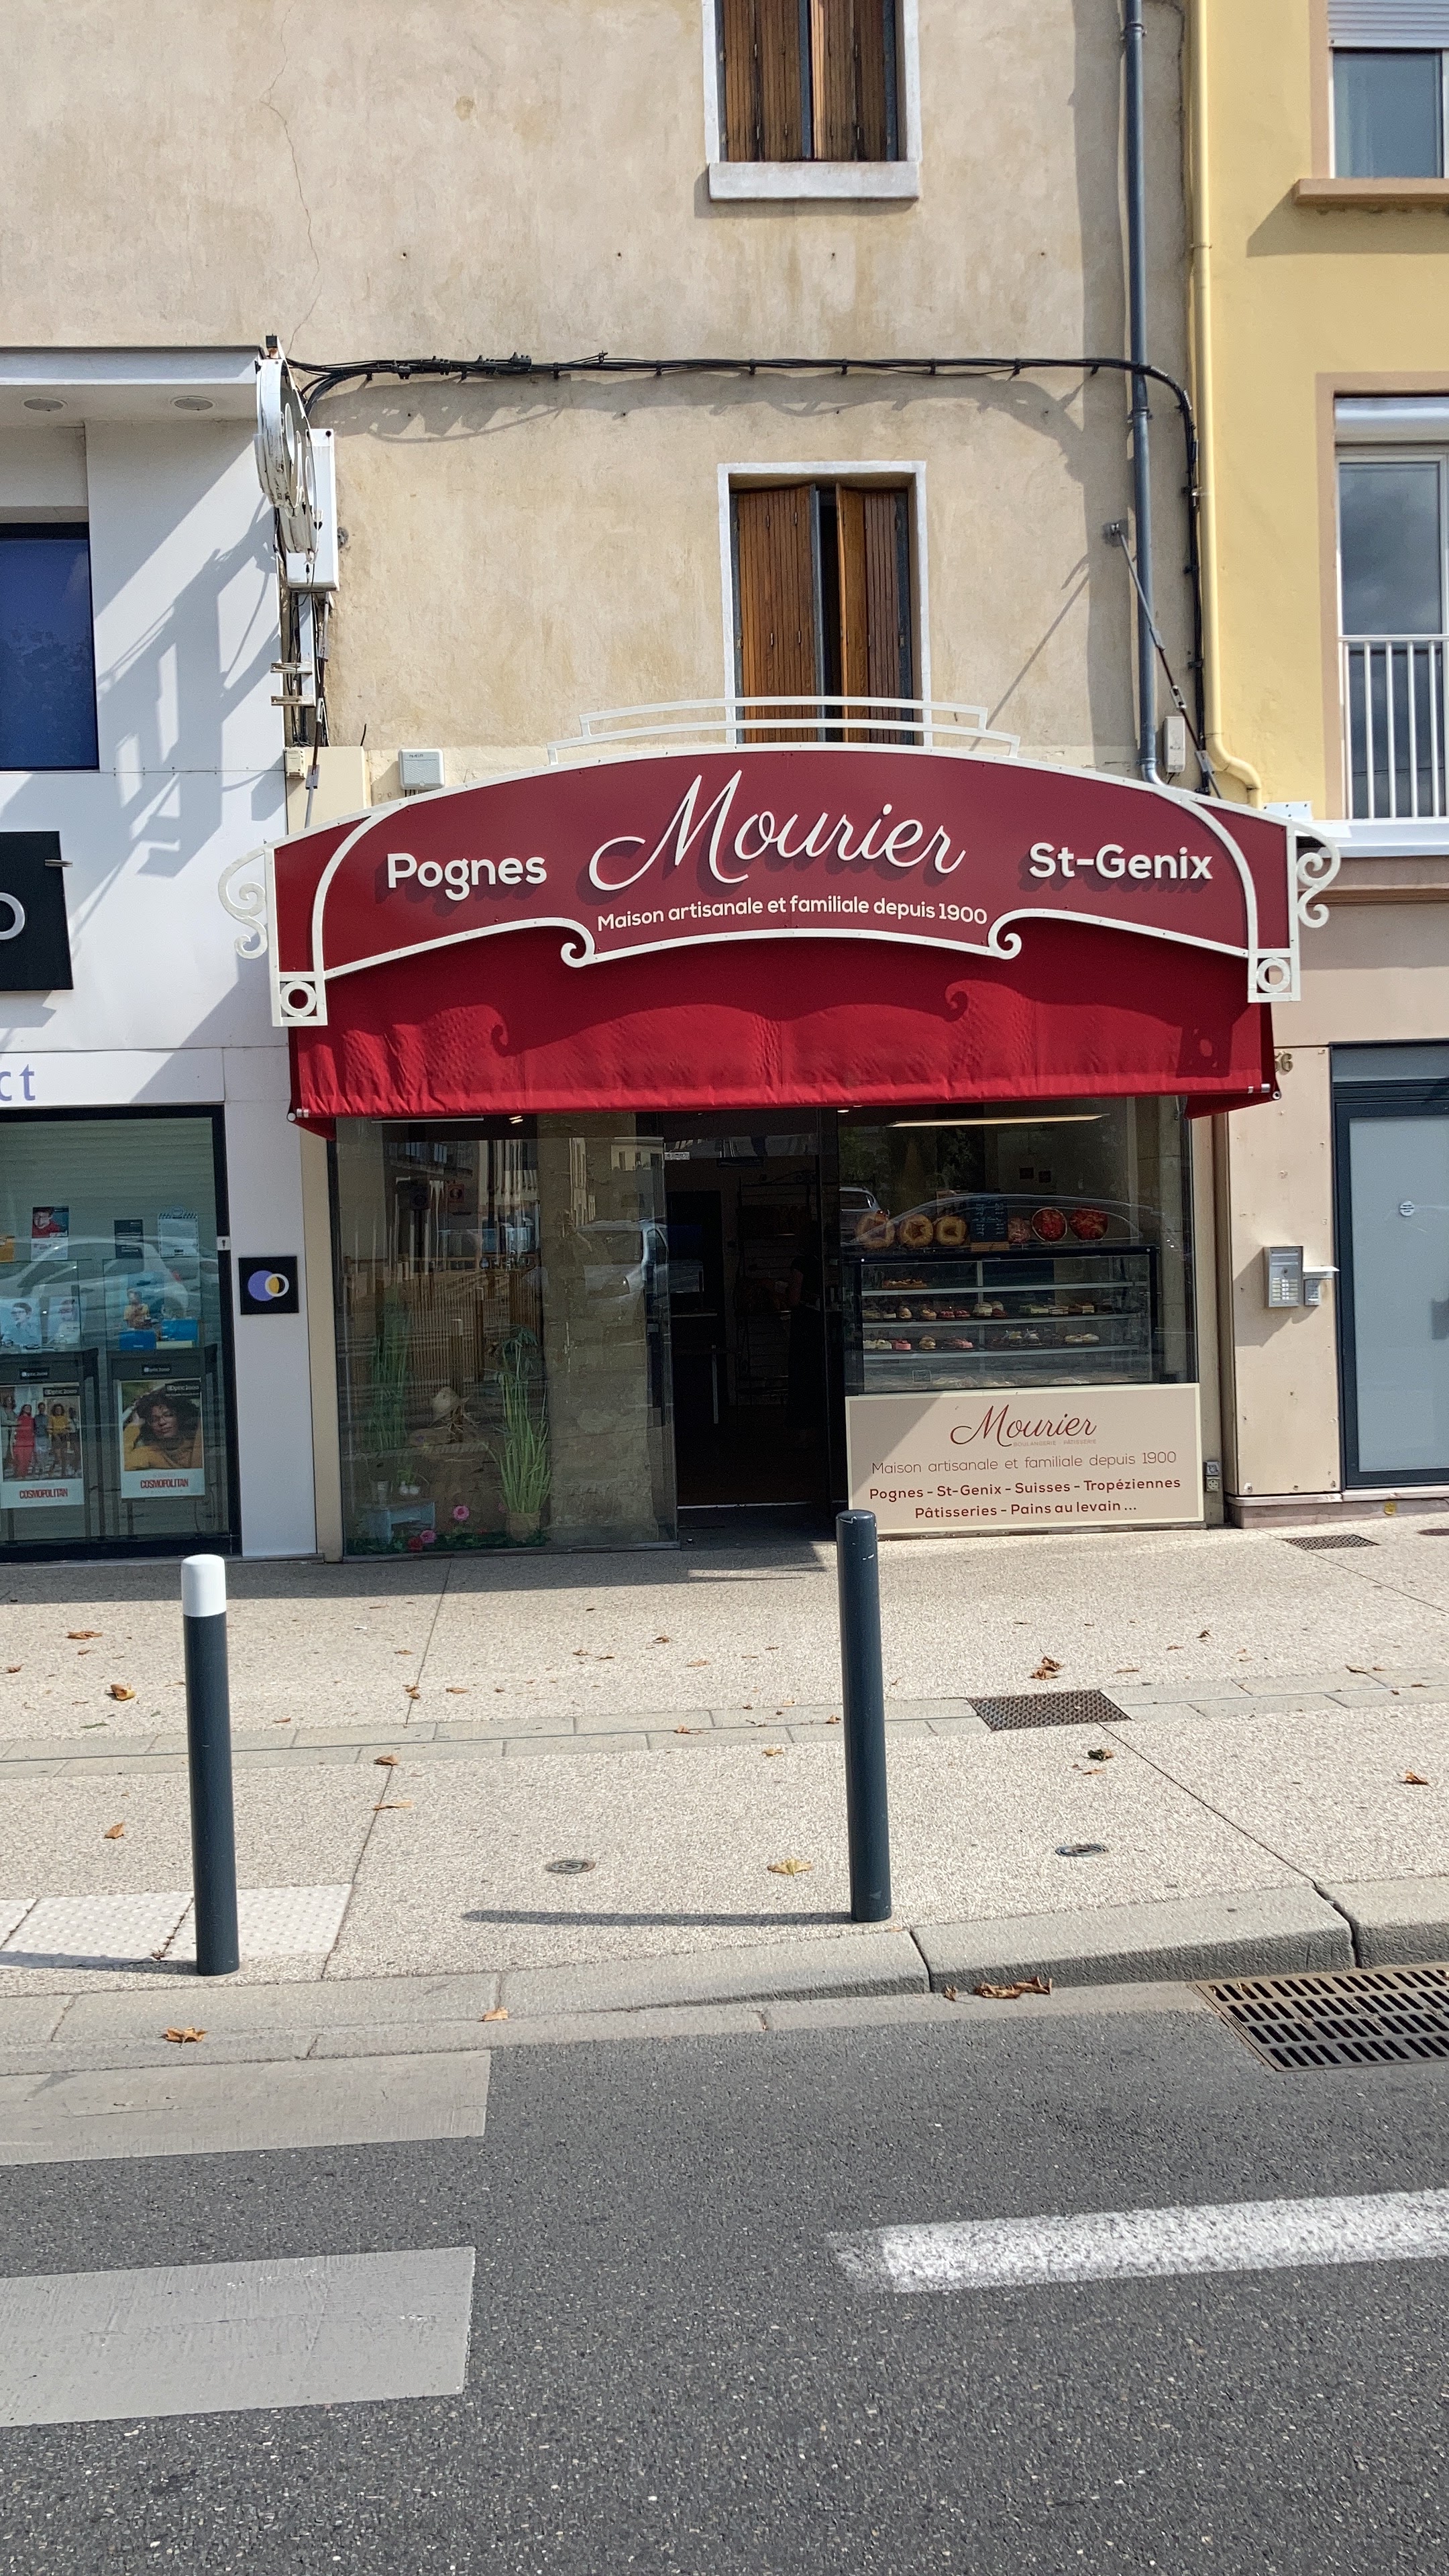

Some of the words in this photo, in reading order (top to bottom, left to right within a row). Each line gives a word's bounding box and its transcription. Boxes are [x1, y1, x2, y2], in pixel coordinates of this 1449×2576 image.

[589, 769, 966, 891] Mourier
[1028, 843, 1213, 880] St-Genix
[387, 853, 547, 901] Pognes
[597, 910, 664, 932] Maison
[668, 897, 763, 921] artisanale
[767, 896, 787, 913] et
[790, 895, 869, 914] familiale
[873, 898, 936, 920] depuis
[938, 903, 988, 925] 1900
[950, 1404, 1097, 1447] Mourier
[872, 1462, 922, 1474] Maison
[928, 1458, 998, 1472] artisanale
[1004, 1458, 1018, 1469] et
[1024, 1454, 1083, 1468] familiale
[1089, 1454, 1136, 1469] depuis
[1142, 1451, 1177, 1464] 1900
[19, 1488, 68, 1499] COSMOPOLITAN
[140, 1478, 189, 1489] COSMOPOLITAN
[869, 1488, 924, 1503] Pognes
[936, 1484, 1002, 1497] St-Genix
[1015, 1482, 1071, 1493] Suisses
[1083, 1479, 1181, 1493] Tropéziennes
[915, 1505, 997, 1519] Pâtisseries
[1011, 1503, 1051, 1515] Pains
[1055, 1504, 1073, 1513] au
[1077, 1501, 1121, 1512] levain
